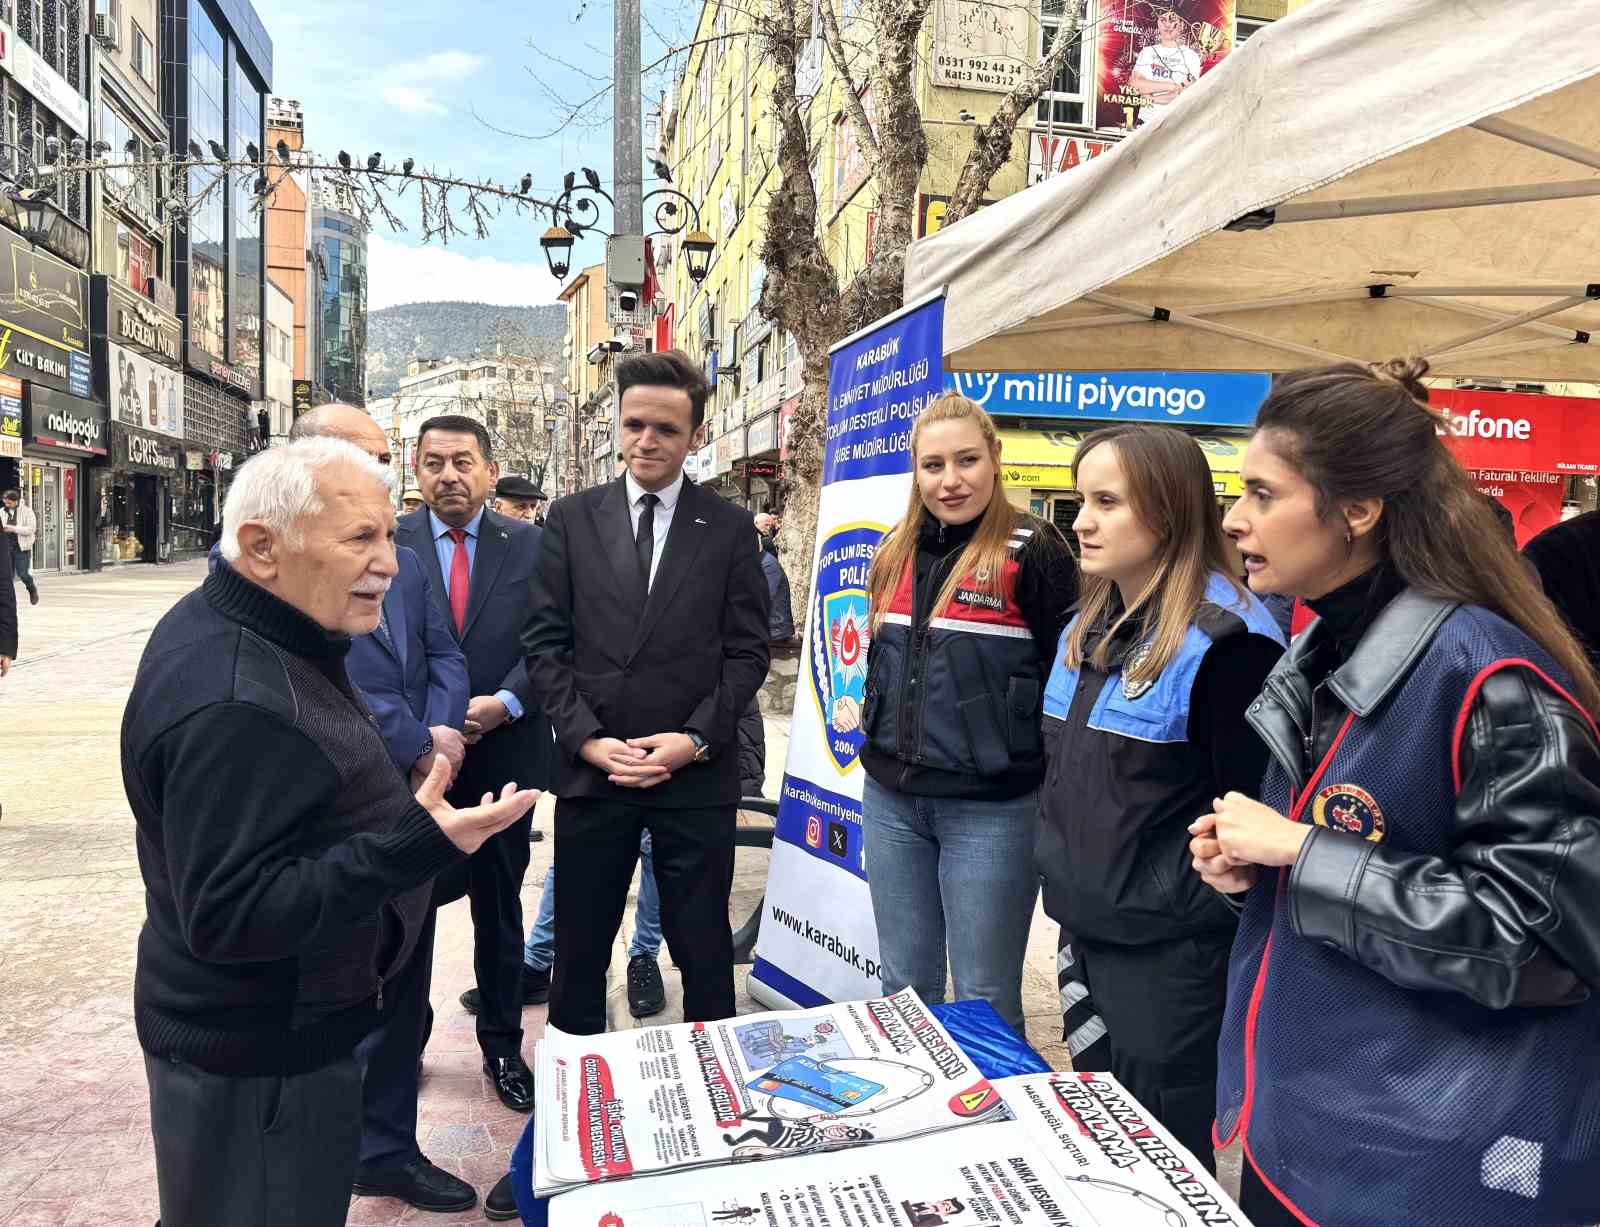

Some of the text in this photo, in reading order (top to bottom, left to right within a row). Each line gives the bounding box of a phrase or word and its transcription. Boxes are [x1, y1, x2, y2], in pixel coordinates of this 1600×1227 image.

[939, 56, 1021, 74] 0531 992 44 34
[945, 69, 972, 81] Kat:3
[37, 356, 67, 378] BAKIMI
[856, 336, 900, 371] KARABÜK
[840, 383, 870, 408] EMNİYET
[872, 358, 928, 397] MÜDÜRLÜĞÜ
[1004, 374, 1206, 415] milli piyango
[826, 418, 849, 440] TOPLUM
[849, 402, 889, 432] DESTEKLİ
[852, 430, 912, 460] MÜDÜRLÜĞÜ
[1479, 471, 1518, 482] Faturalı
[1520, 472, 1560, 484] Teklifler
[856, 544, 878, 560] DES
[958, 590, 1003, 609] JANDARMA
[834, 740, 855, 756] 2006
[865, 1001, 916, 1054] KİRALAMA
[891, 993, 968, 1080] BANKA HESABINI
[585, 1058, 611, 1168] ÖZGÜRLÜĞÜNÜ KAYBEDERSİN
[706, 1083, 740, 1122] DEĞİLDİR
[1081, 1080, 1149, 1136] BANKA
[610, 1124, 626, 1162] OKULUNU
[1022, 1084, 1091, 1167] MASUM DEĞİL, SUÇTUR!
[1048, 1080, 1141, 1168] KİRALAMA
[1008, 1157, 1039, 1184] BANKA
[1026, 1184, 1067, 1220] HESABINI
